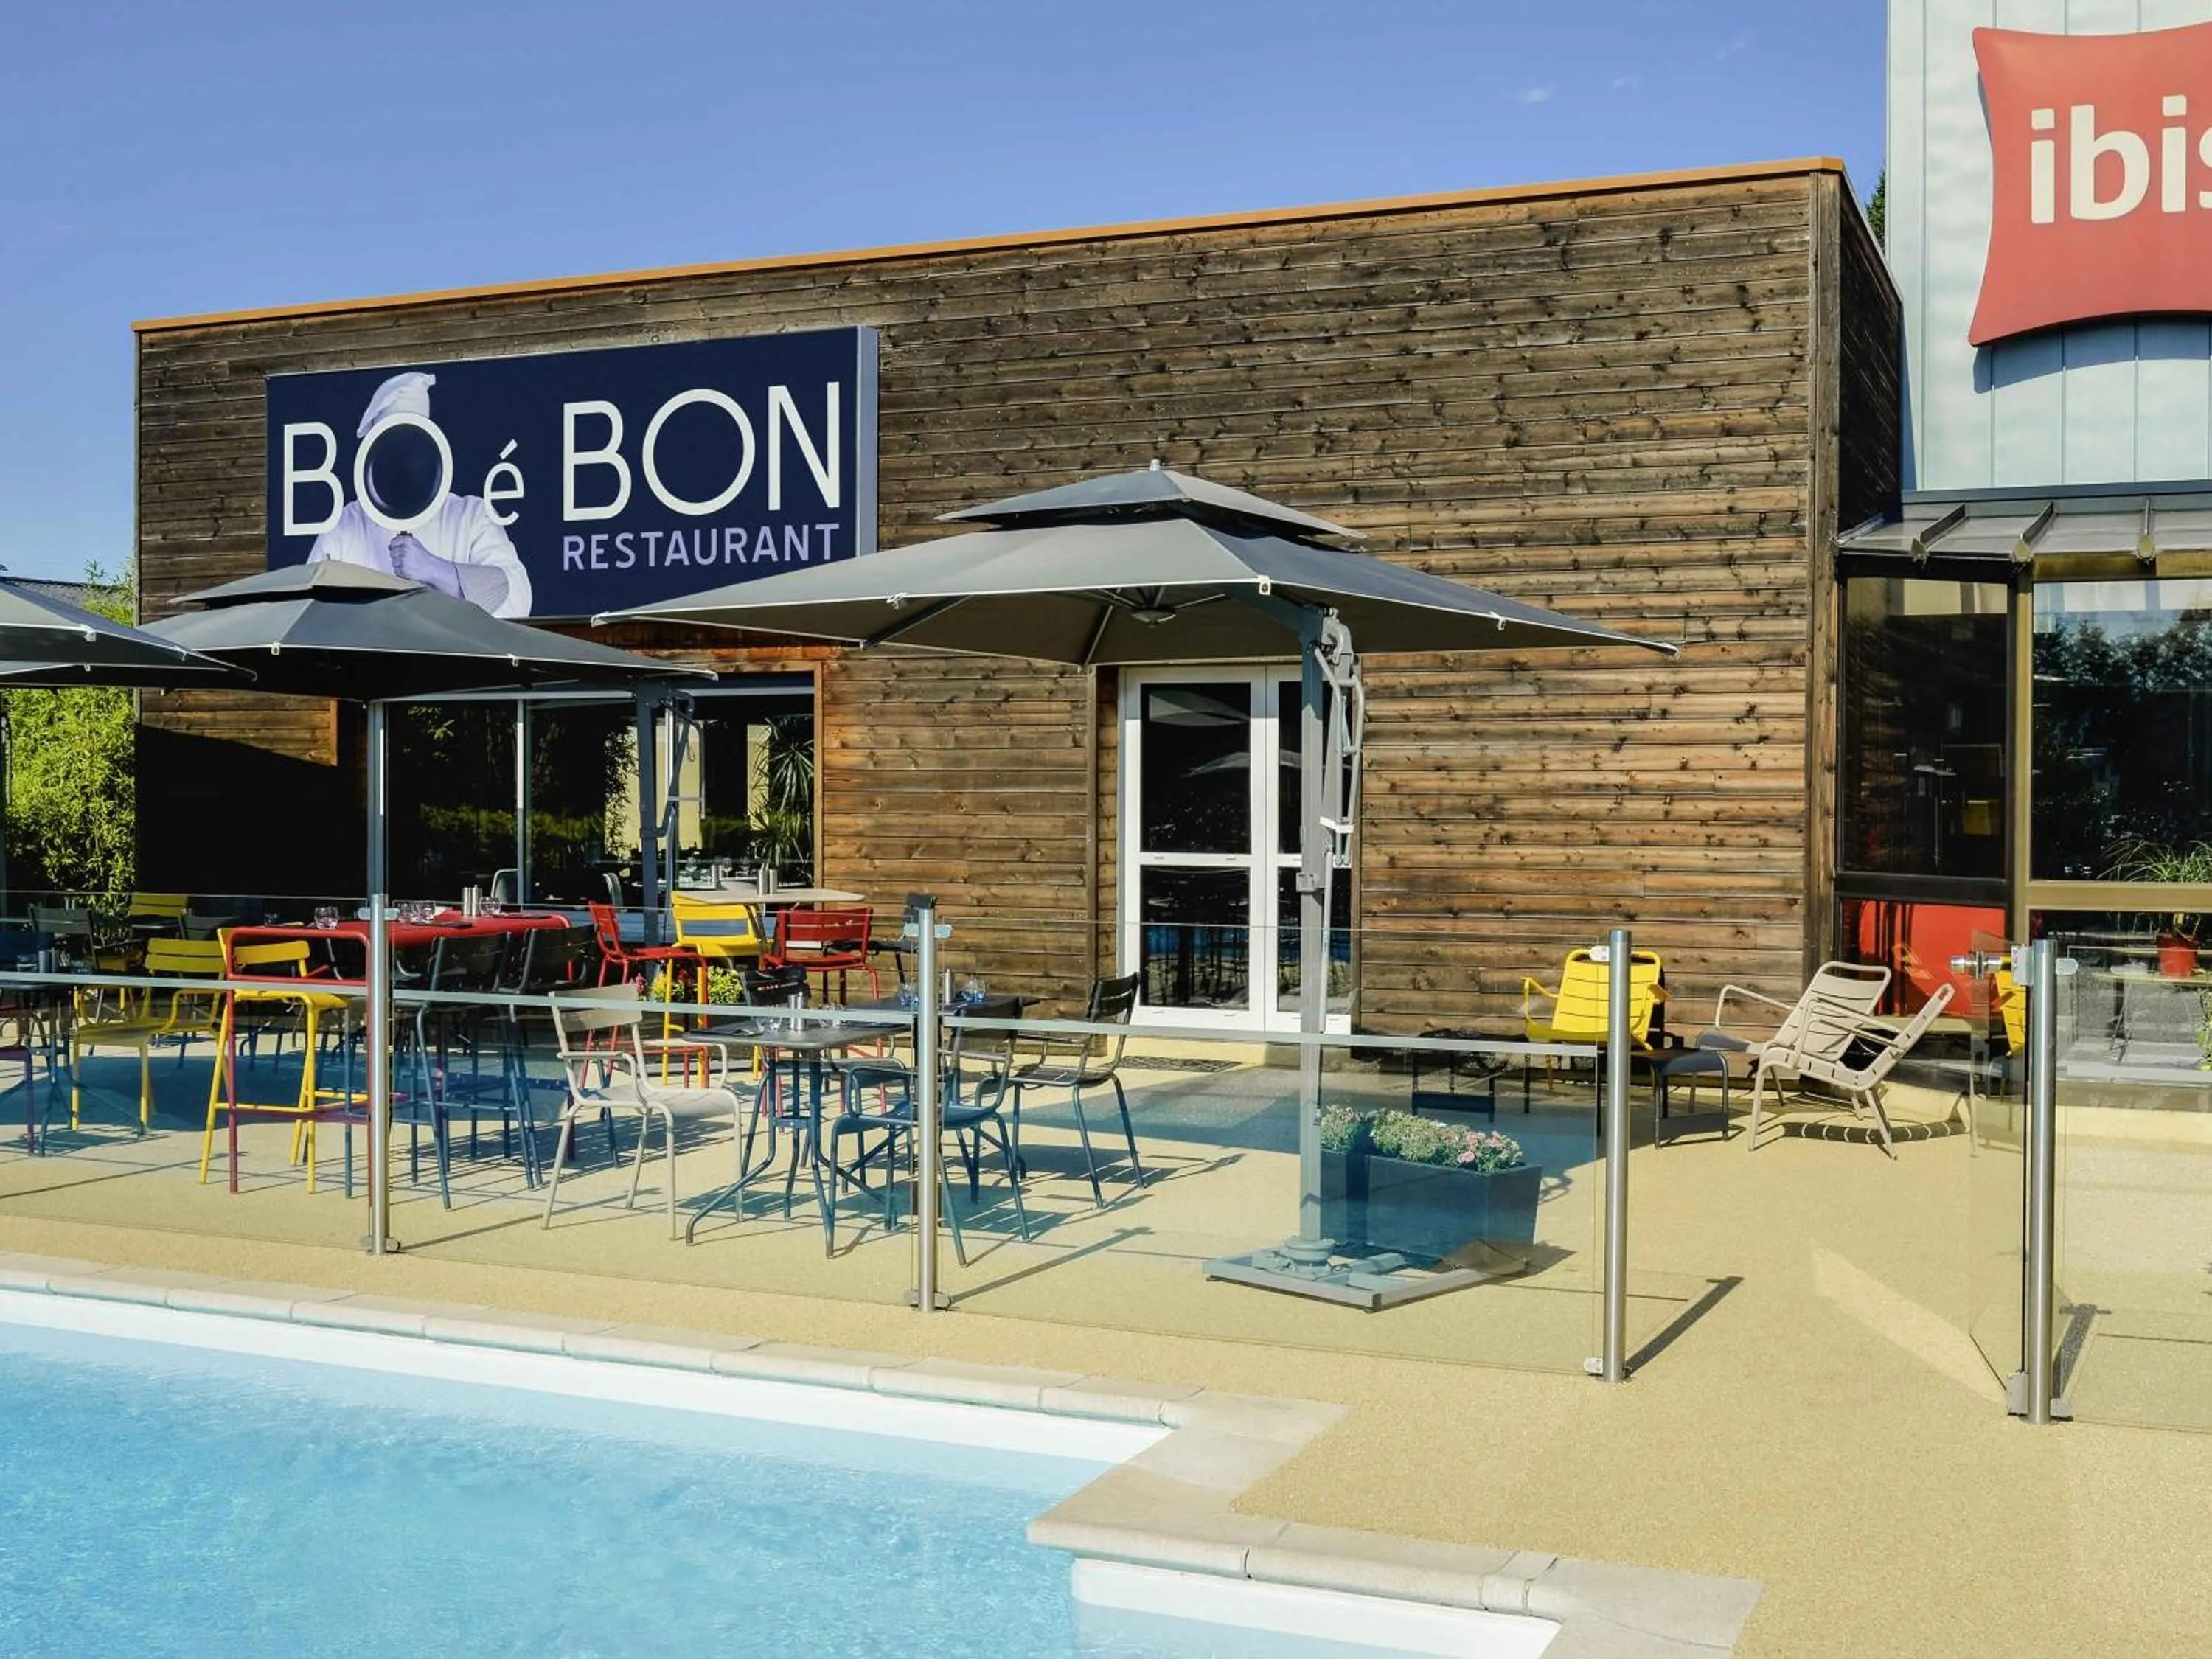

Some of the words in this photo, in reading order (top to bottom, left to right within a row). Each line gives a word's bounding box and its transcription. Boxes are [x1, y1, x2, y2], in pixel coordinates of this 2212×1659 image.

[283, 412, 453, 536] BO
[483, 439, 525, 526] é
[563, 381, 840, 521] BON
[563, 523, 840, 571] RESTAURANT
